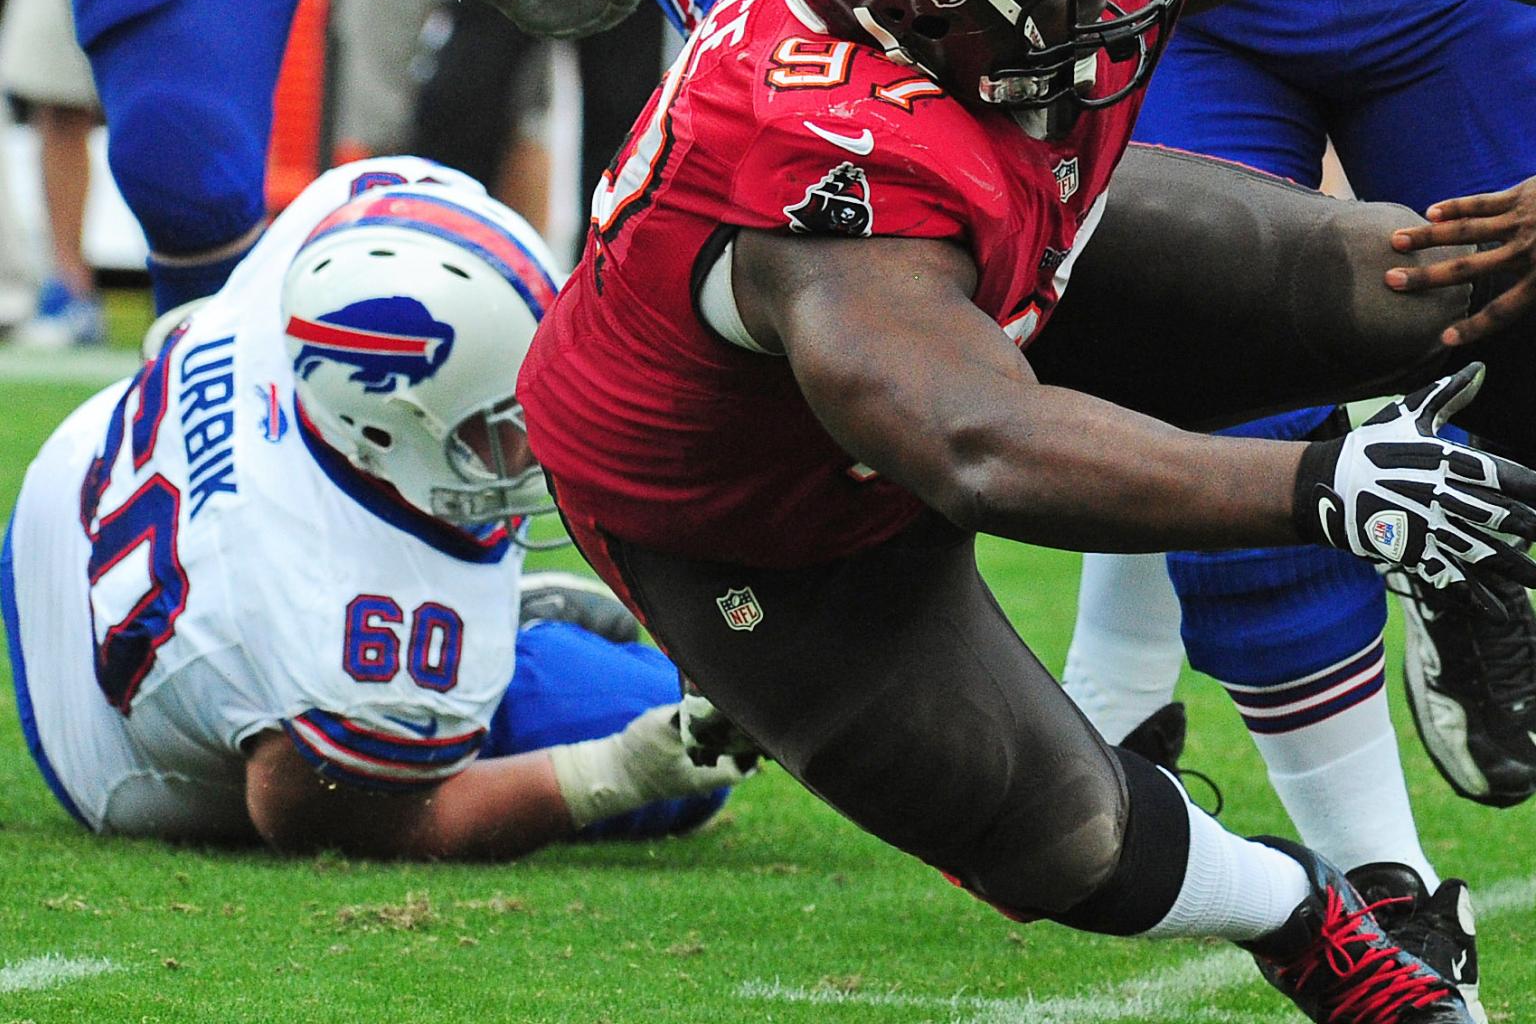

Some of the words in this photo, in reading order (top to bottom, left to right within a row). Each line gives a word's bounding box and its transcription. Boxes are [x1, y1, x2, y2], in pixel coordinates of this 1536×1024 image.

[179, 335, 238, 523] URBIK
[1375, 521, 1387, 540] NFL
[342, 593, 464, 694] 60
[730, 604, 759, 625] NFL
